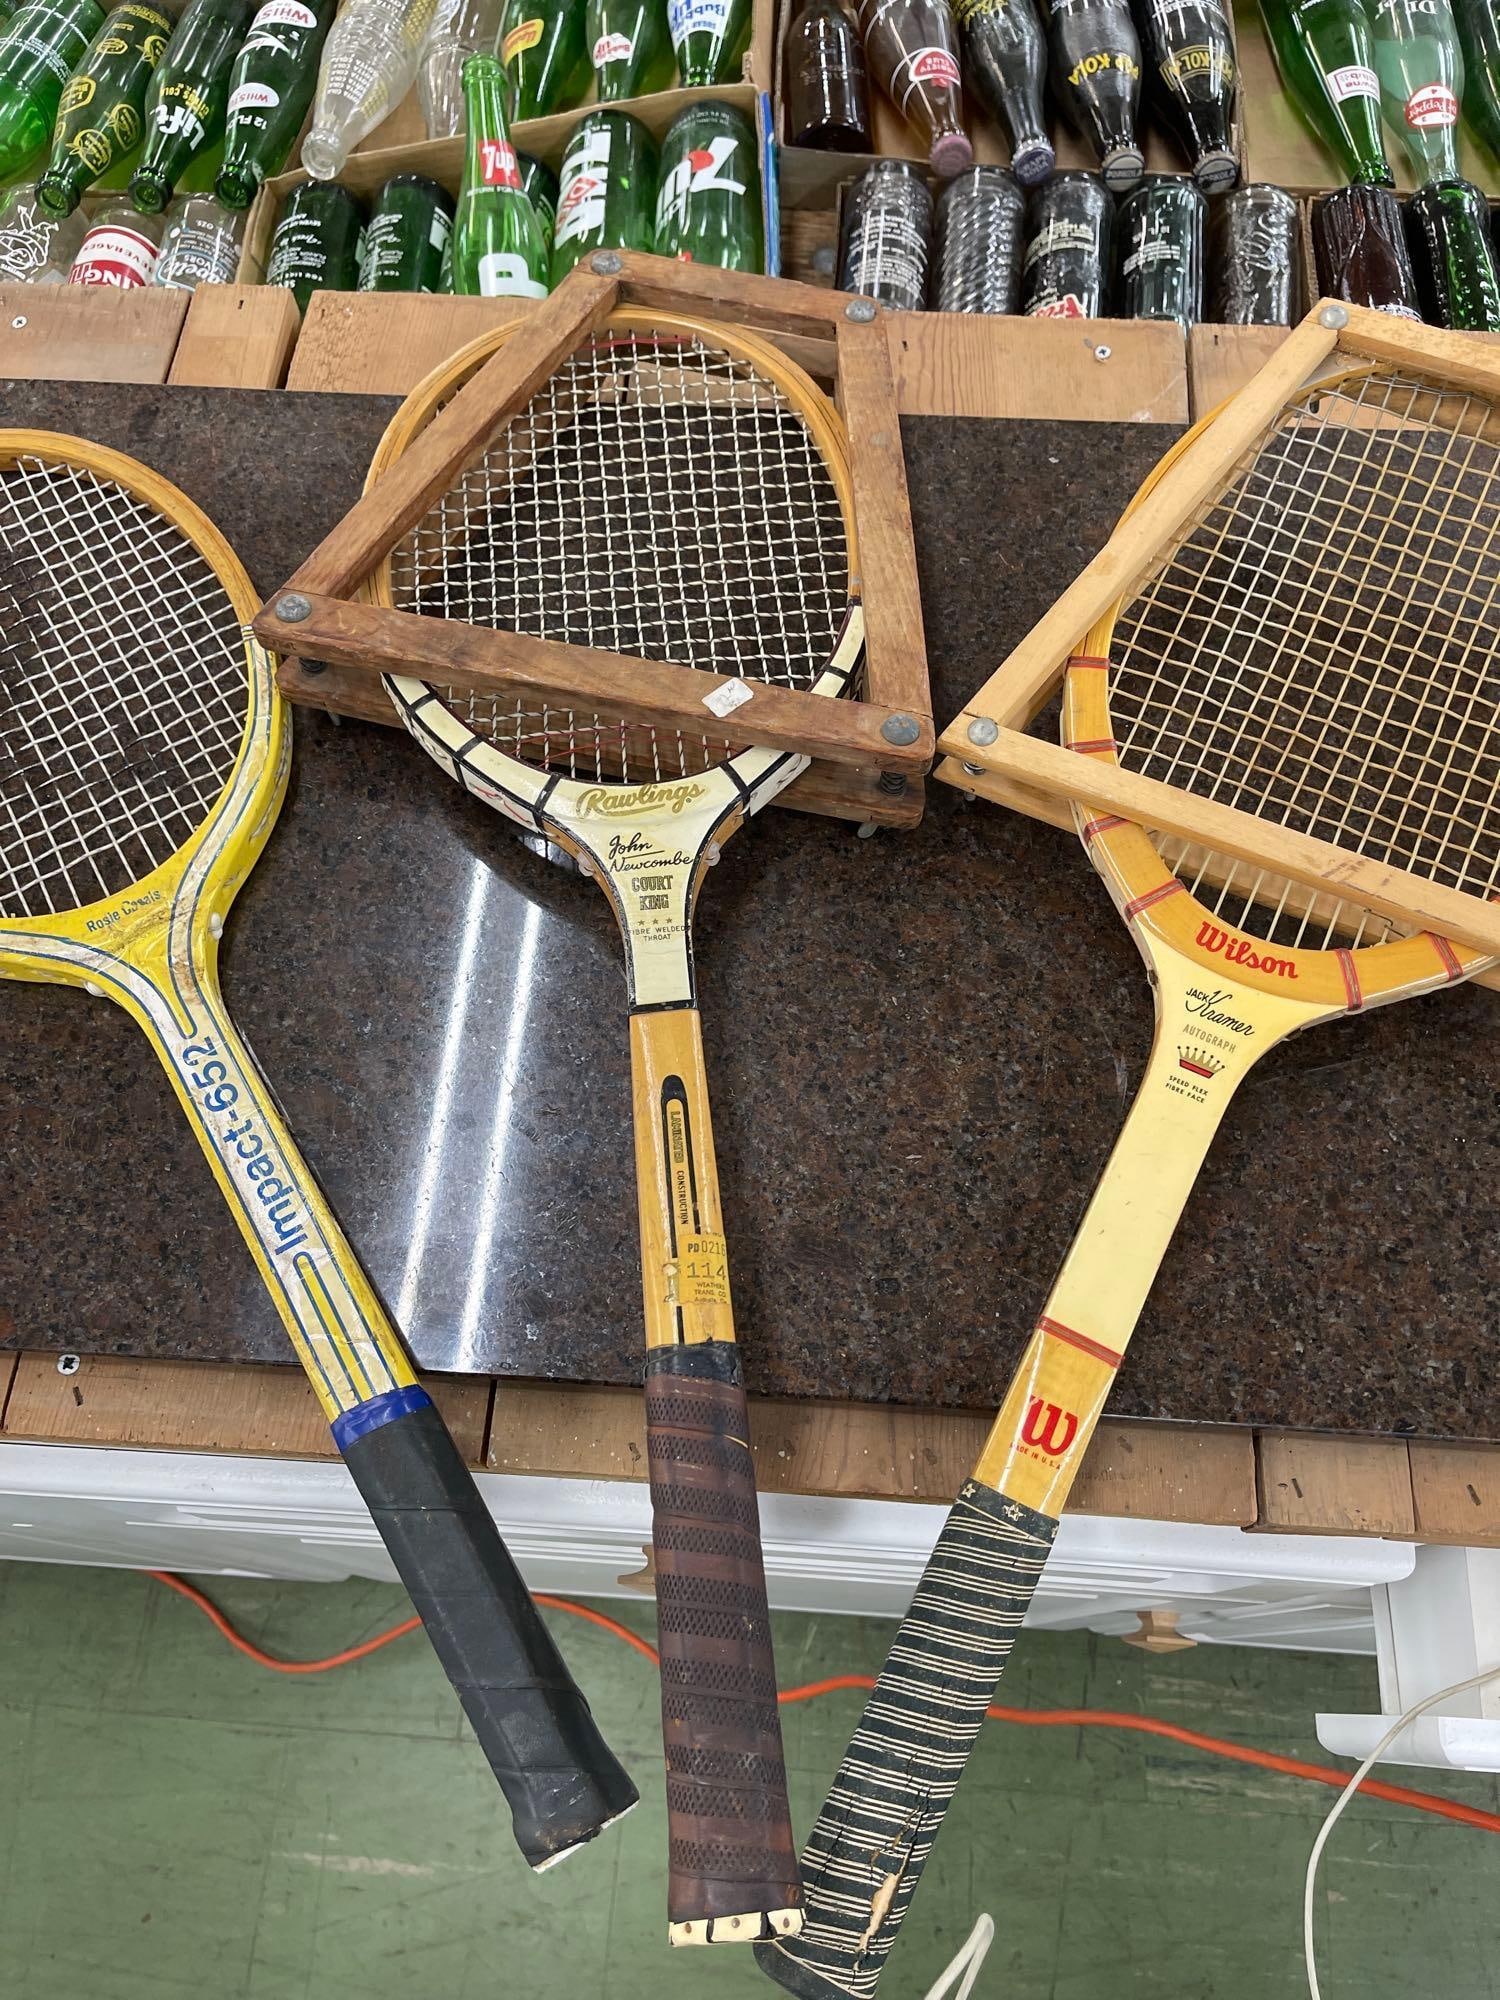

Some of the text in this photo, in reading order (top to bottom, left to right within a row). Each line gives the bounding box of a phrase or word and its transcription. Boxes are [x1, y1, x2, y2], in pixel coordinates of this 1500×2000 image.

[575, 782, 706, 820] Rawlings
[608, 832, 653, 860] John
[609, 850, 695, 873] Newcombe
[631, 875, 674, 892] COURT
[639, 894, 670, 911] KING
[86, 912, 121, 933] Rosie
[643, 933, 672, 942] THROAT
[1195, 920, 1299, 980] Wilson
[1186, 987, 1210, 1003] JACK
[1185, 989, 1256, 1037] Kramer
[1182, 1024, 1237, 1054] AUTOGRAPH
[1165, 1082, 1206, 1104] FIBRE FACE
[1168, 1074, 1209, 1097] SPEED FLEX
[676, 1170, 689, 1226] CONSTRUCTION
[687, 1242, 700, 1253] PD
[686, 1261, 727, 1281] 114
[1021, 1395, 1079, 1457] W
